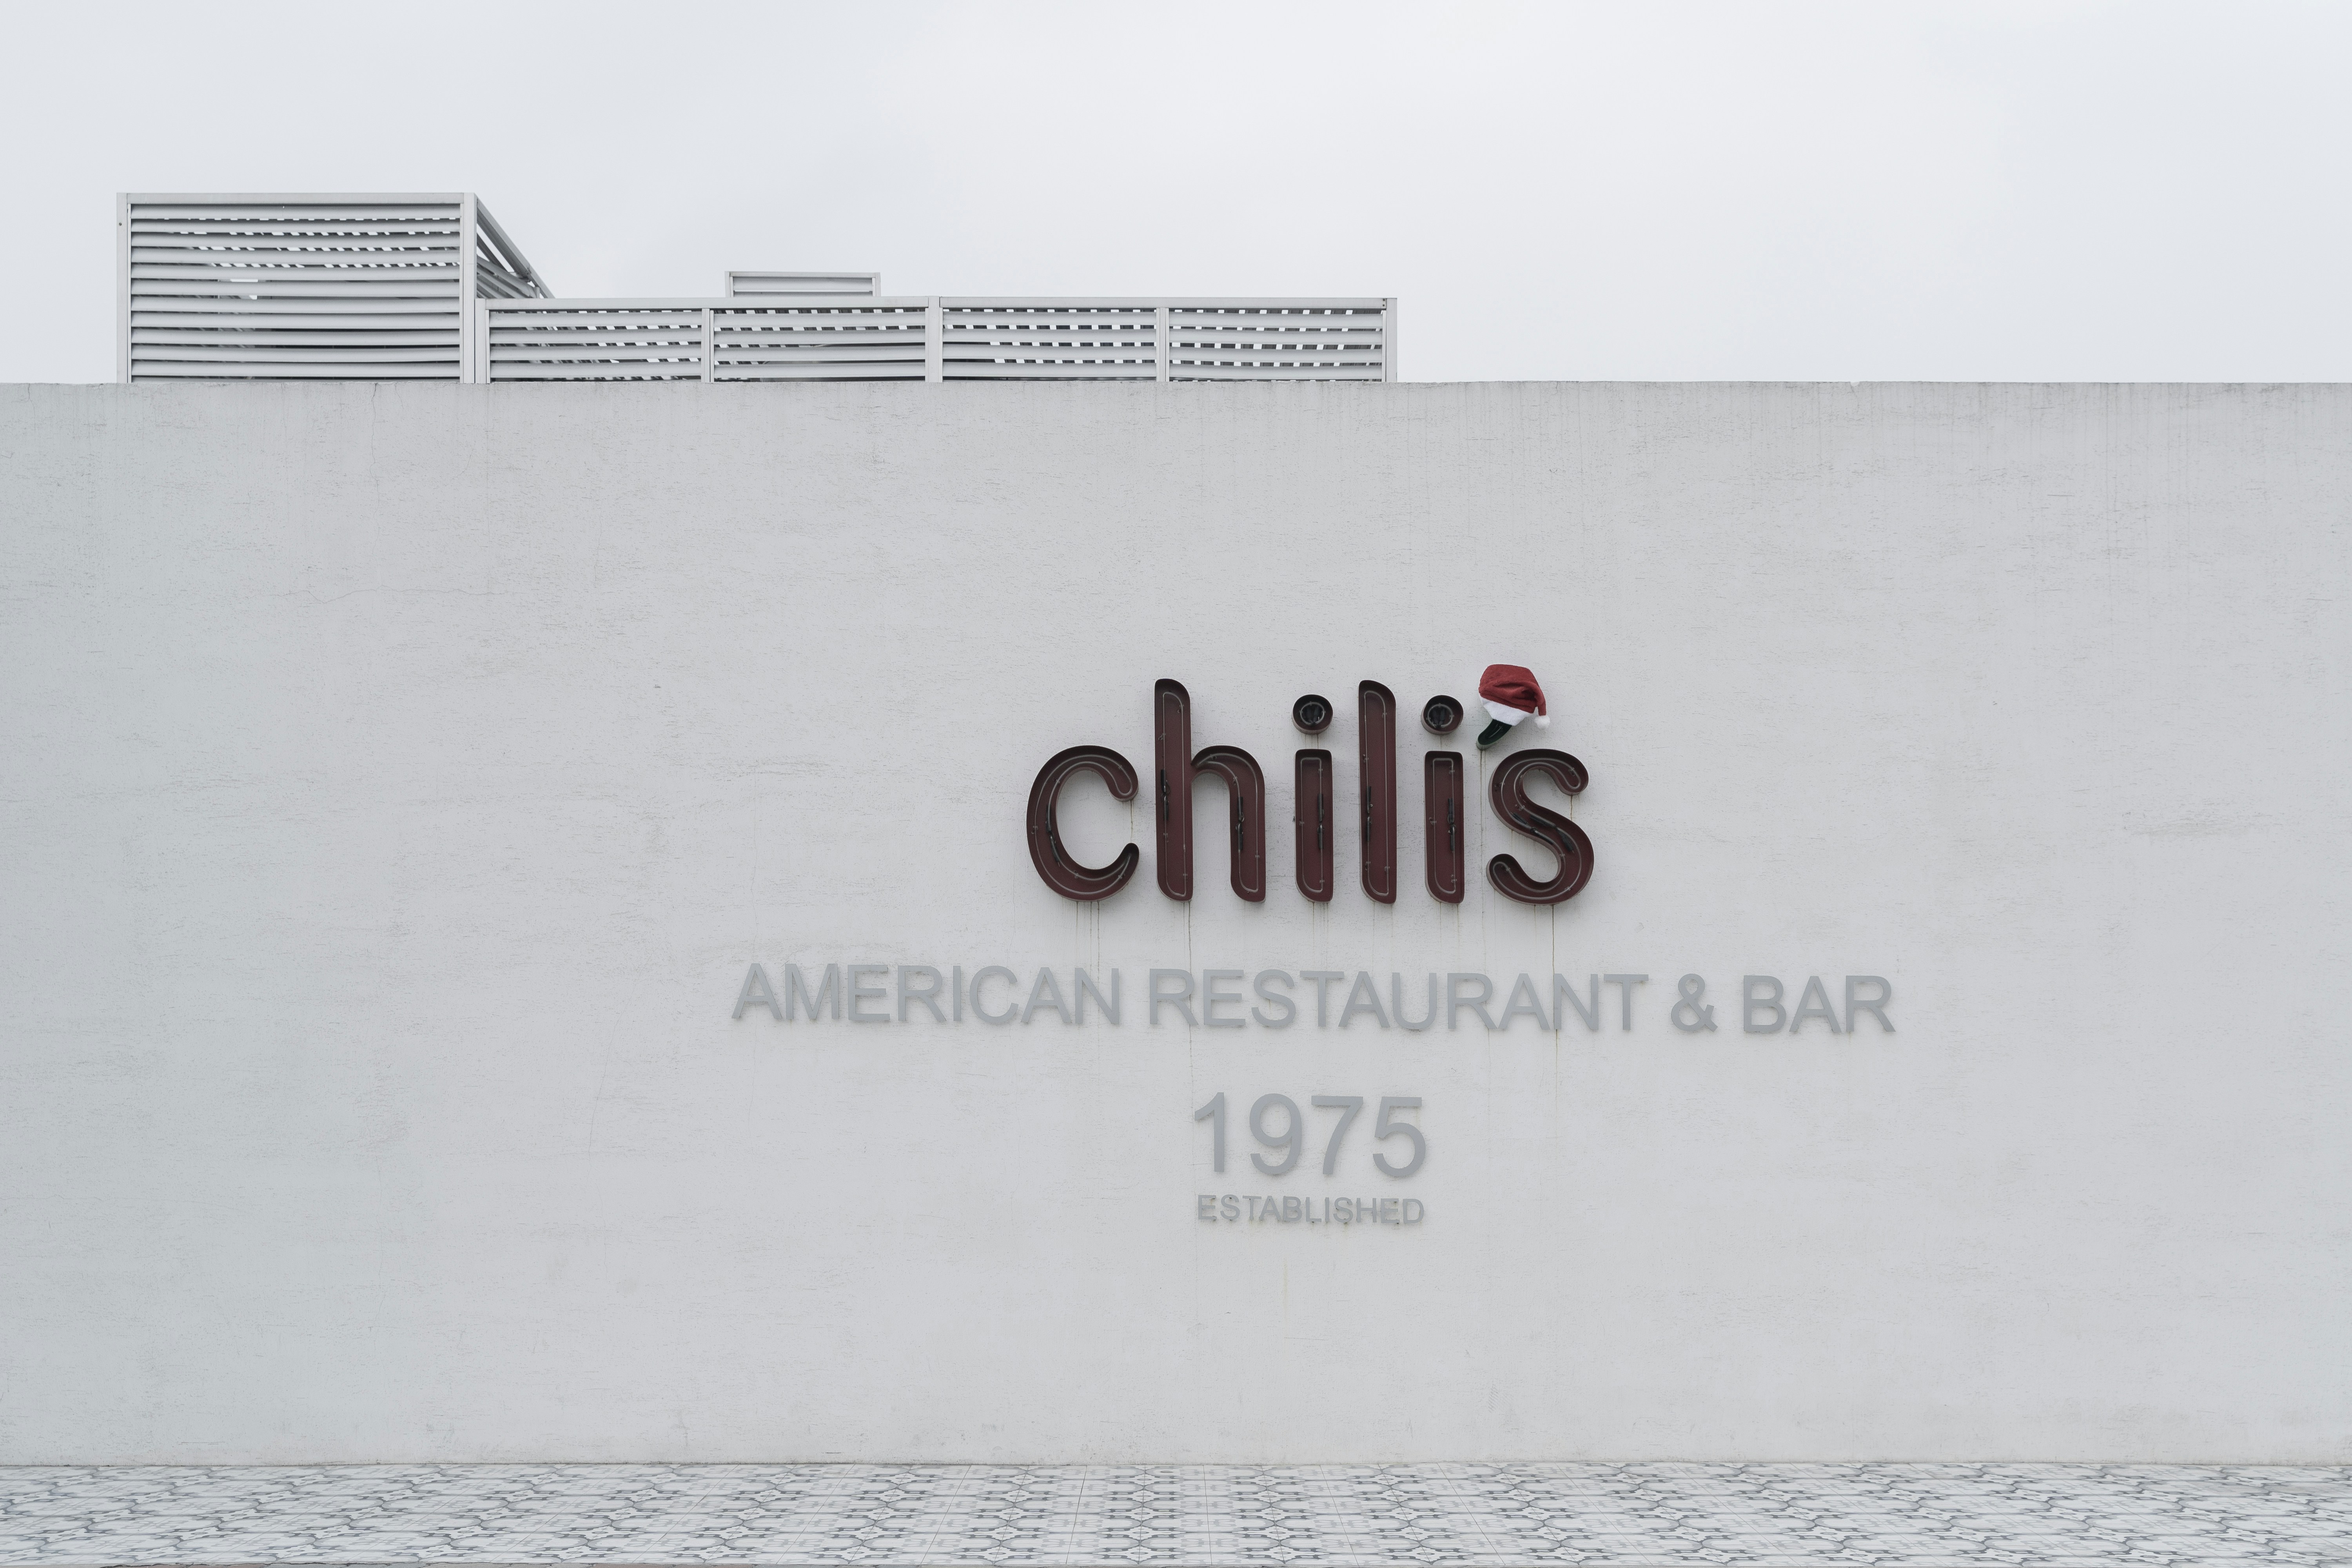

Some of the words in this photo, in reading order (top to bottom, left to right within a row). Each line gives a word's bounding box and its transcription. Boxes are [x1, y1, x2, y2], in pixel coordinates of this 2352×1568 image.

[731, 963, 1120, 1025] AMERICAN
[1149, 968, 1649, 1031] RESTAURANT
[1670, 973, 1718, 1033] &
[1743, 975, 1896, 1033] BAR
[1194, 1092, 1426, 1176] 1975
[1198, 1194, 1425, 1224] ESTABLISHED
